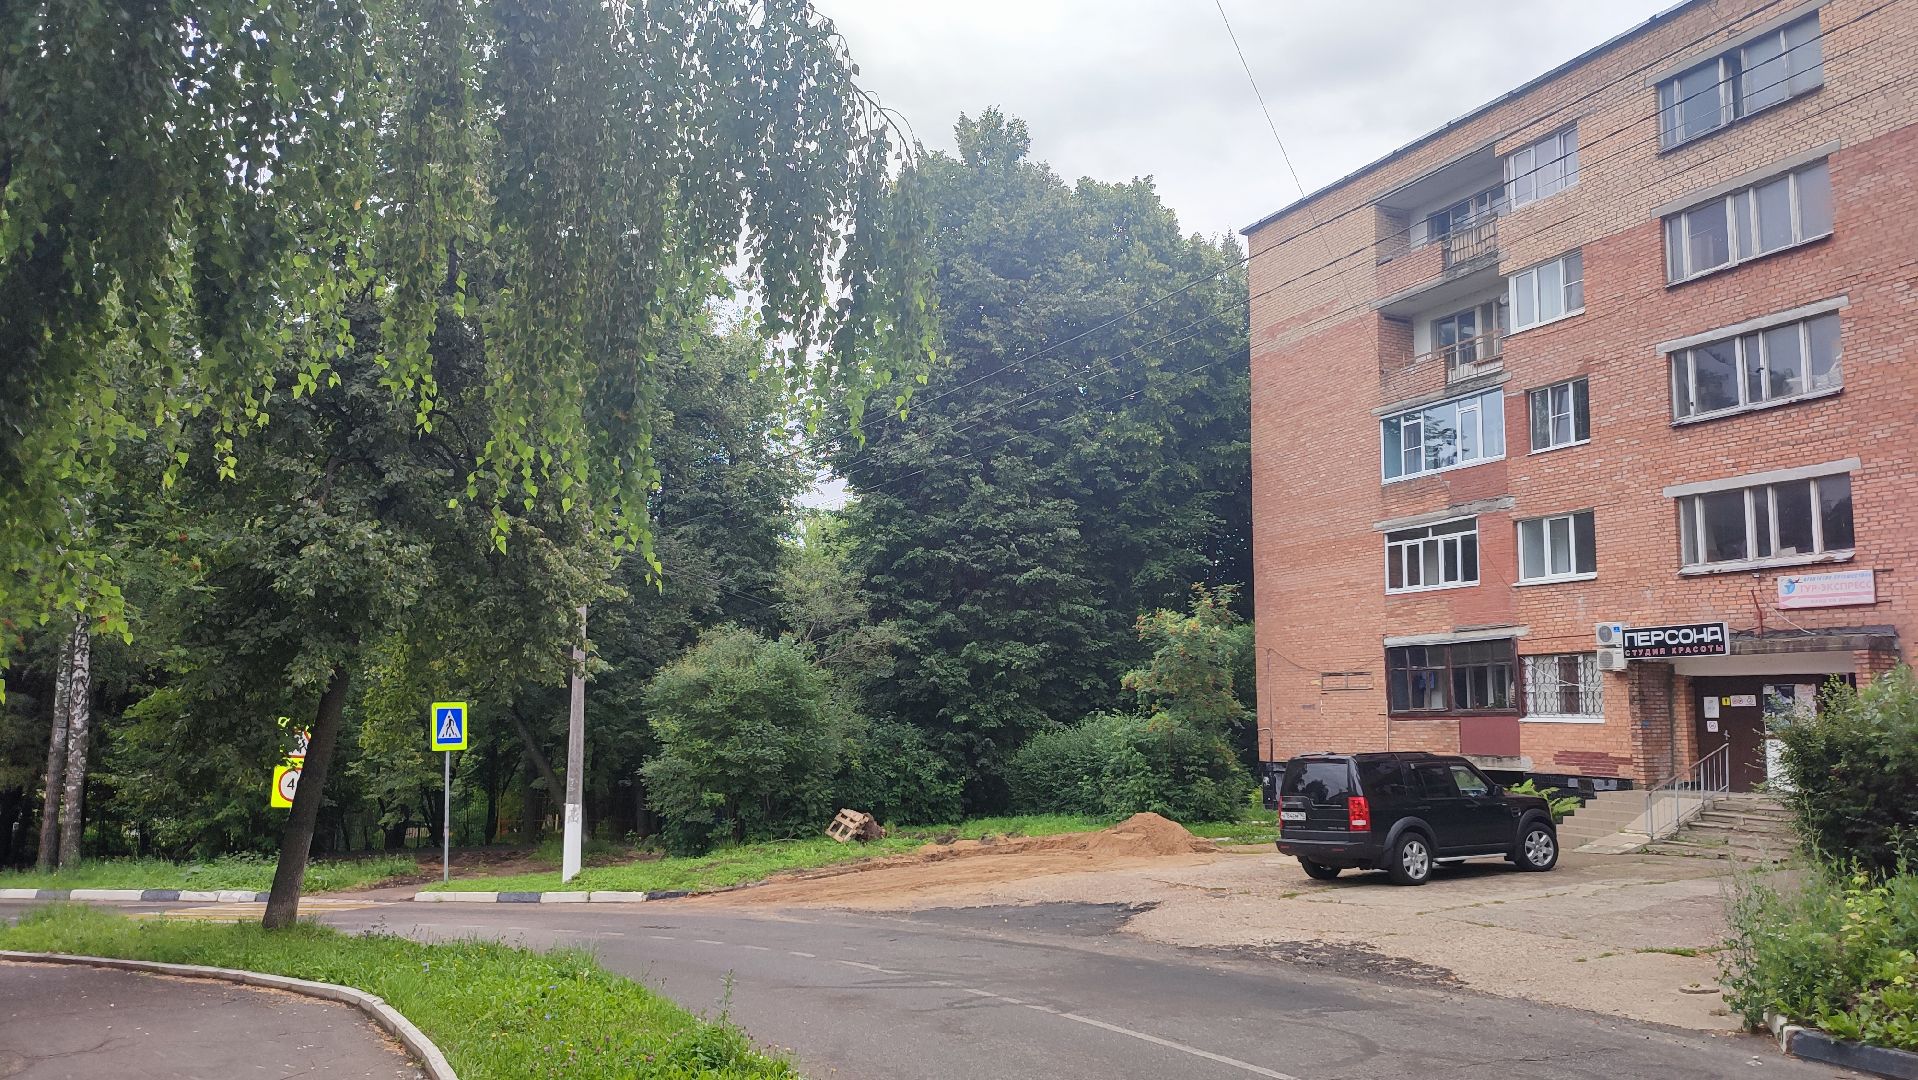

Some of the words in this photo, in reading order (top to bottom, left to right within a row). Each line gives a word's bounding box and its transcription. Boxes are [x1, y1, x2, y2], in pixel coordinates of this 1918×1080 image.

[1624, 626, 1723, 647] ПЕРСОНА
[1625, 647, 1666, 657] СТУДИЯ
[1671, 644, 1724, 655] КРАСОТЫ
